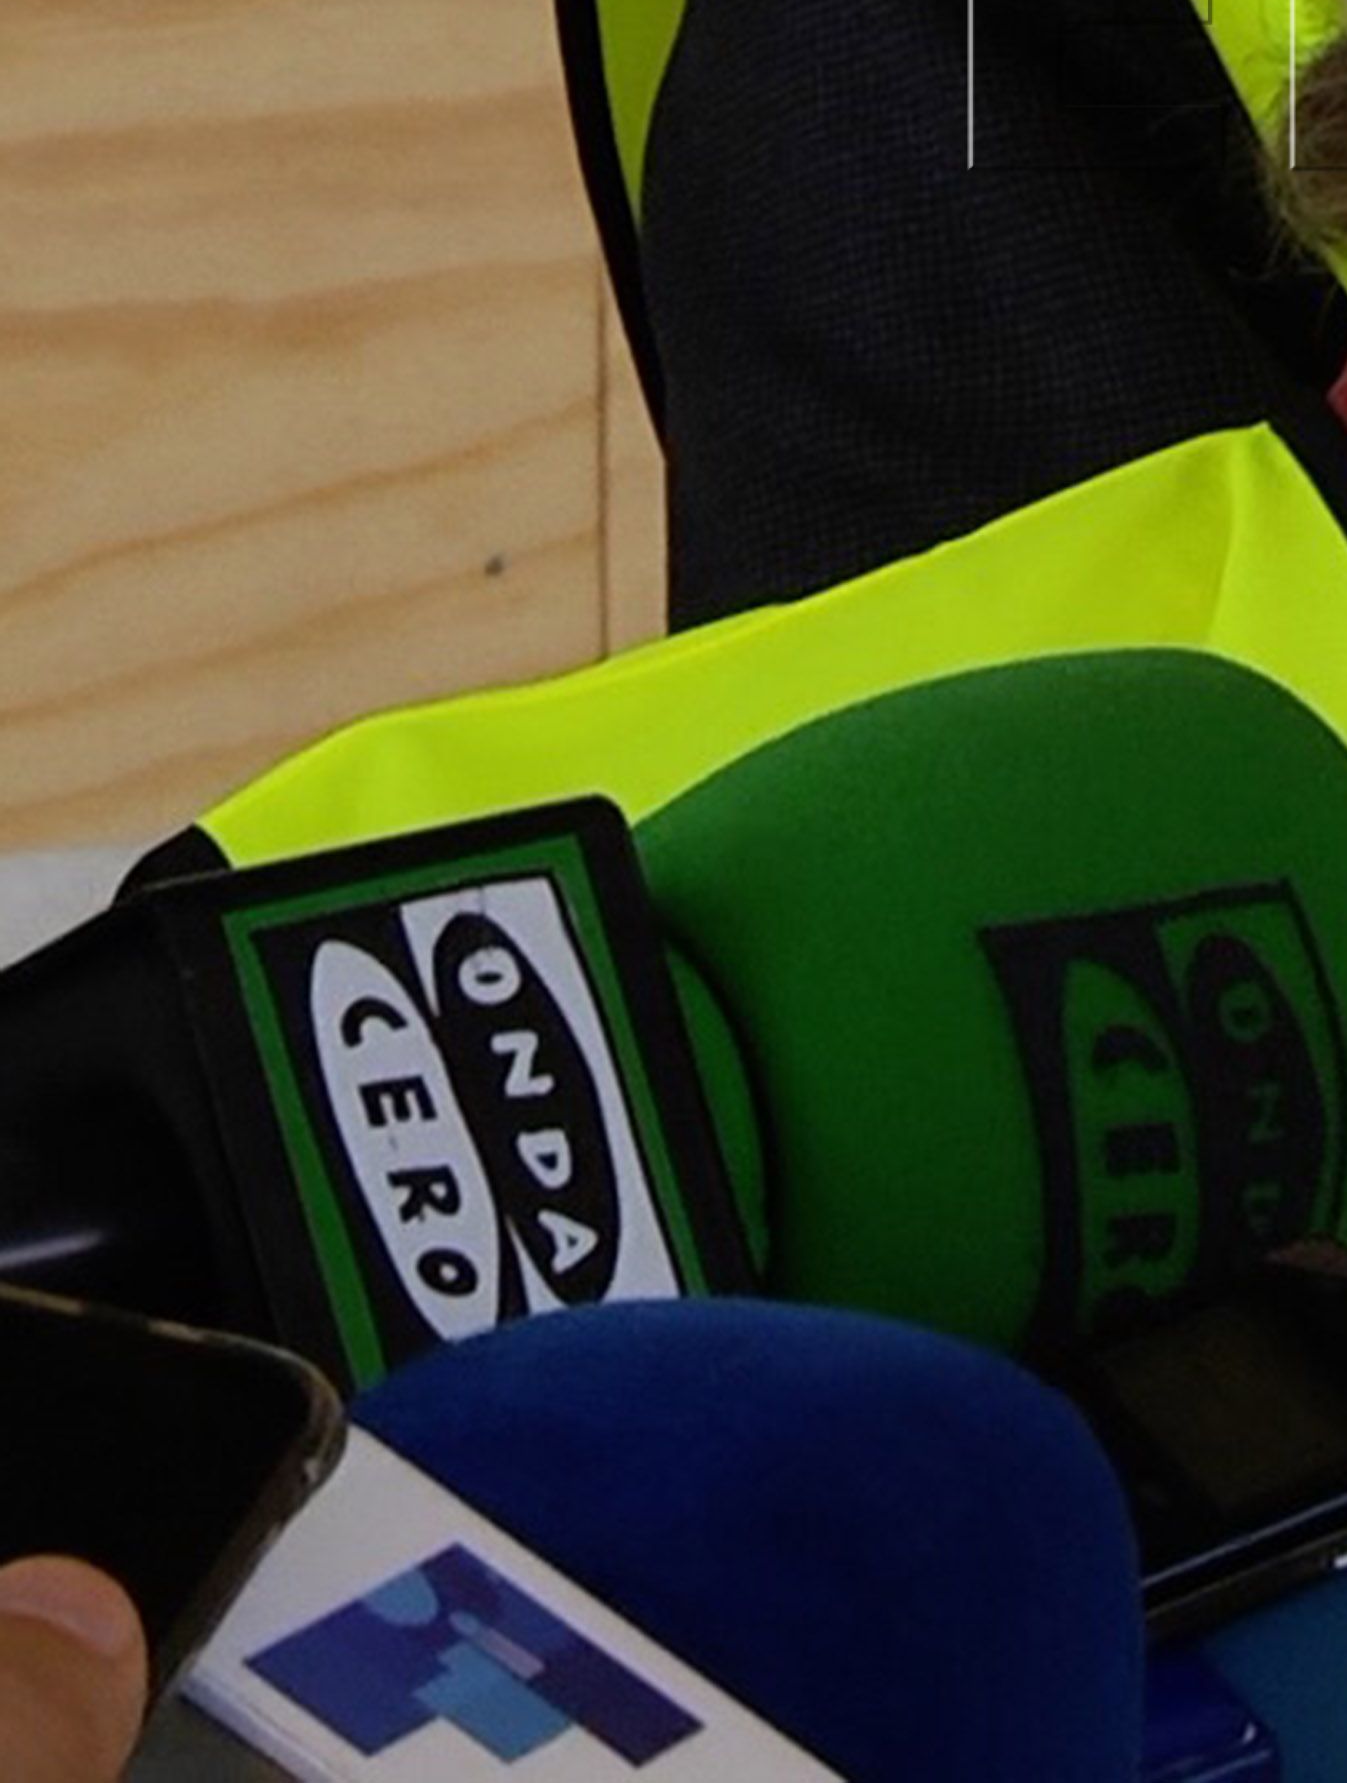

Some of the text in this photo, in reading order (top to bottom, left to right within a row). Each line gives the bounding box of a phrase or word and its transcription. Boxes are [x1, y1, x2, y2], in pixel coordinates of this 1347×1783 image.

[339, 996, 479, 1298] CERO
[457, 945, 600, 1276] ONDA
[1217, 977, 1288, 1238] OND
